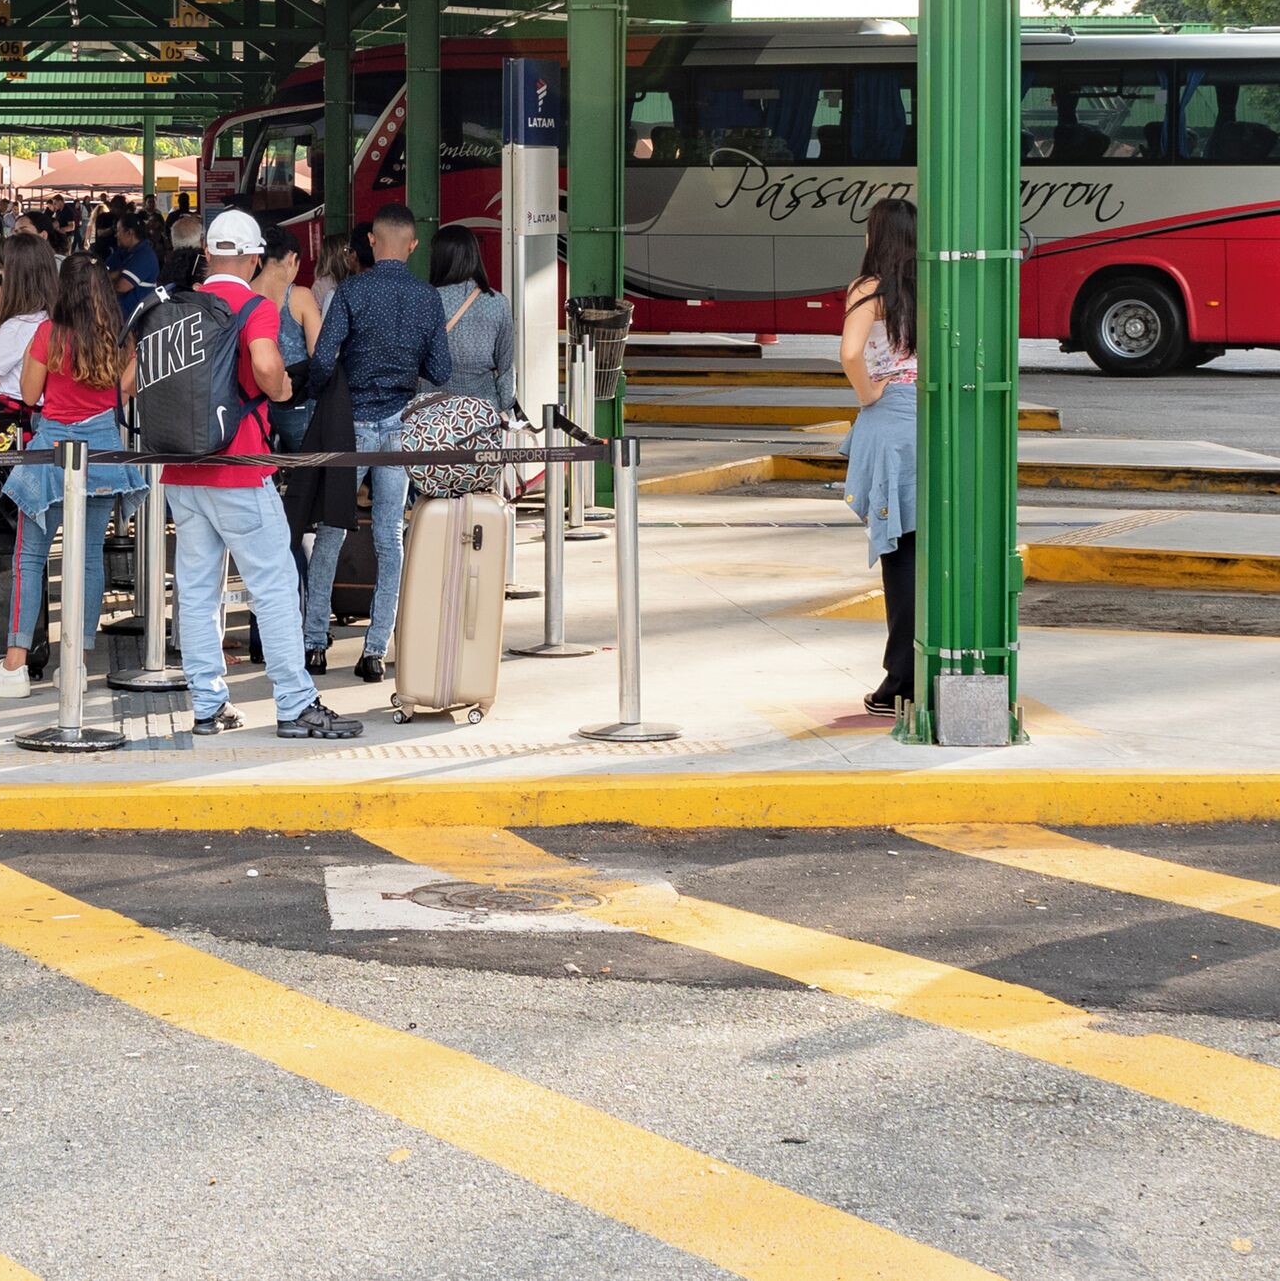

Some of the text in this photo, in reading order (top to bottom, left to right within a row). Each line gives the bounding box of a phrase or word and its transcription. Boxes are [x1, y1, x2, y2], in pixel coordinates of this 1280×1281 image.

[0, 41, 21, 55] 06
[165, 46, 183, 60] 05
[527, 117, 555, 129] LATAM
[709, 147, 1125, 224] Pássaro rron
[533, 213, 558, 224] LATAM
[136, 311, 206, 394] NIKE
